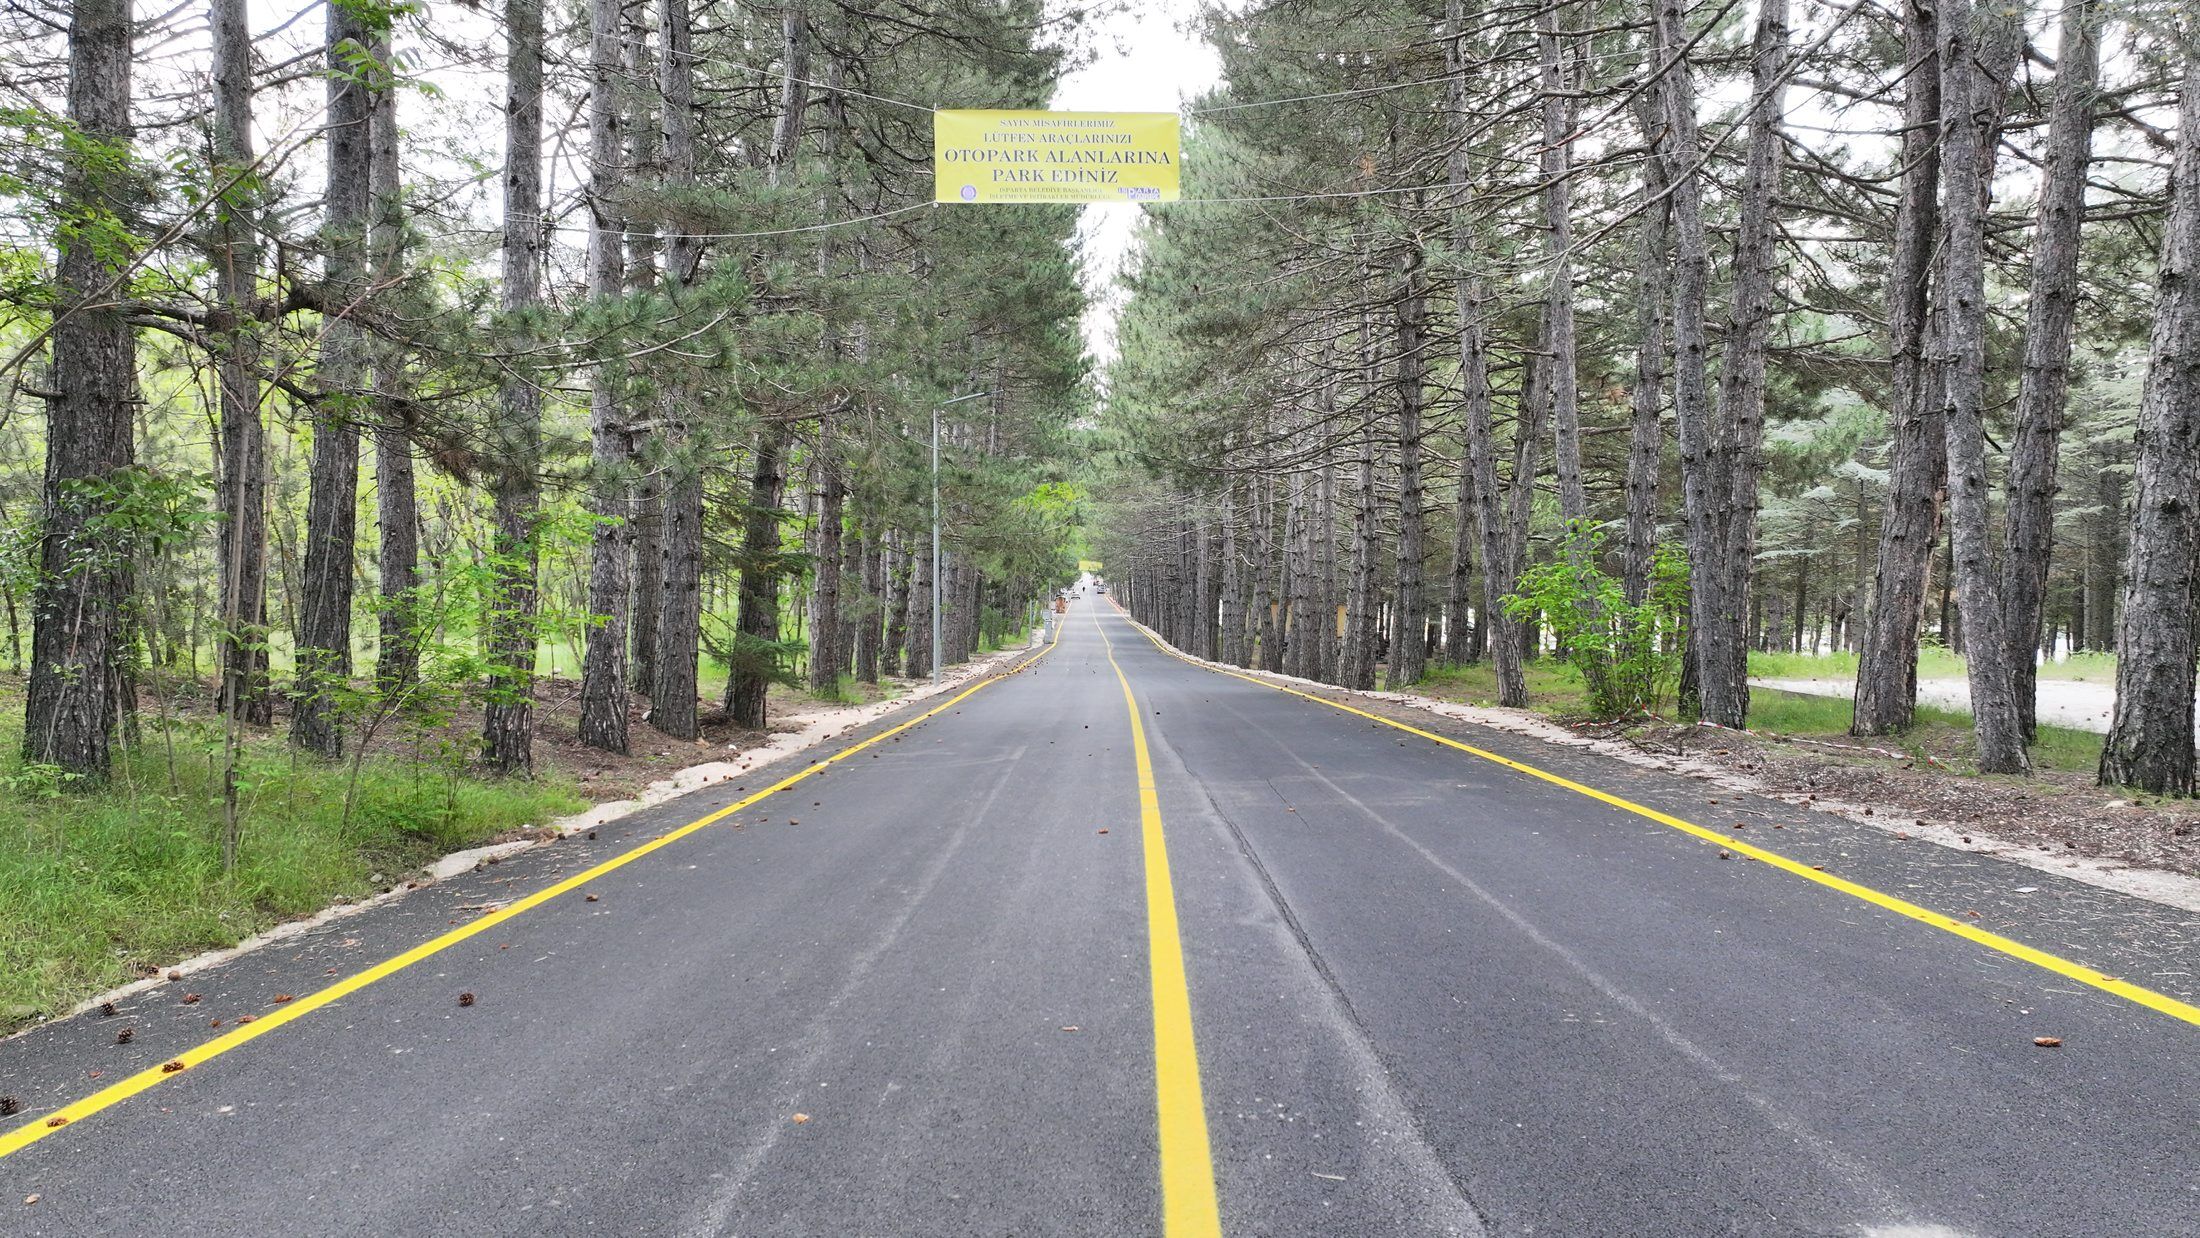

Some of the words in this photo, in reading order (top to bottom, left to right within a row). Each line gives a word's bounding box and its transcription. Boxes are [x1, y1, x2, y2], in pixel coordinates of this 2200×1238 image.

[1000, 119, 1029, 127] SAYIN
[984, 131, 1035, 142] LÜTFEN
[1040, 132, 1131, 144] ARAÇLARINIZI
[945, 149, 1039, 162] OTOPARK
[1045, 149, 1170, 164] ALANLARINA
[993, 169, 1044, 182] PARK
[1052, 167, 1118, 183] EDİNİZ
